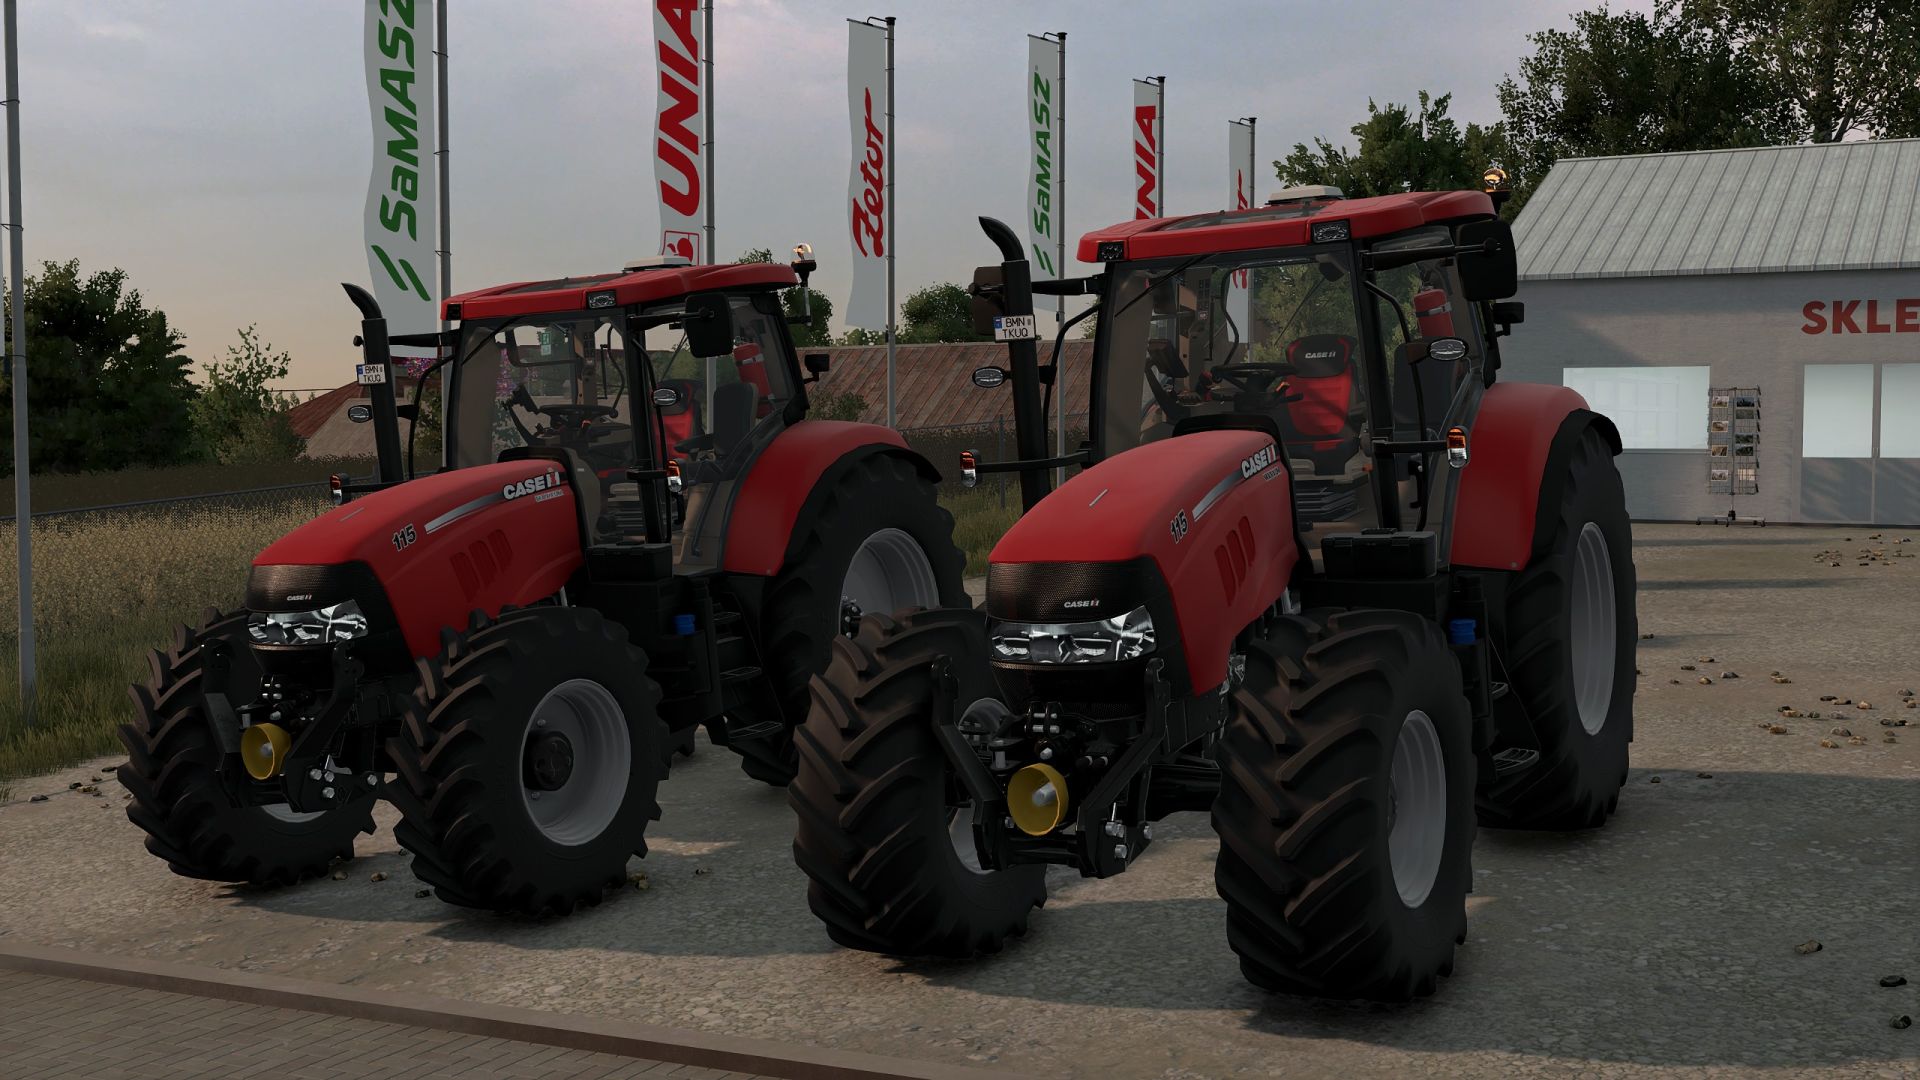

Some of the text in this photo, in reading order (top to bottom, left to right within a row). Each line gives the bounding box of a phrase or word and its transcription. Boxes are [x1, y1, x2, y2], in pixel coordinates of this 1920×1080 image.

[656, 0, 700, 216] UNIA
[852, 86, 884, 258] Zetor
[1135, 105, 1156, 220] NIA
[1002, 327, 1029, 339] TKUQ
[1005, 317, 1026, 328] BMN
[1241, 448, 1268, 479] CASE
[503, 475, 546, 500] CASE
[392, 523, 417, 552] 115
[1170, 509, 1189, 544] 115
[1063, 600, 1090, 608] CASE
